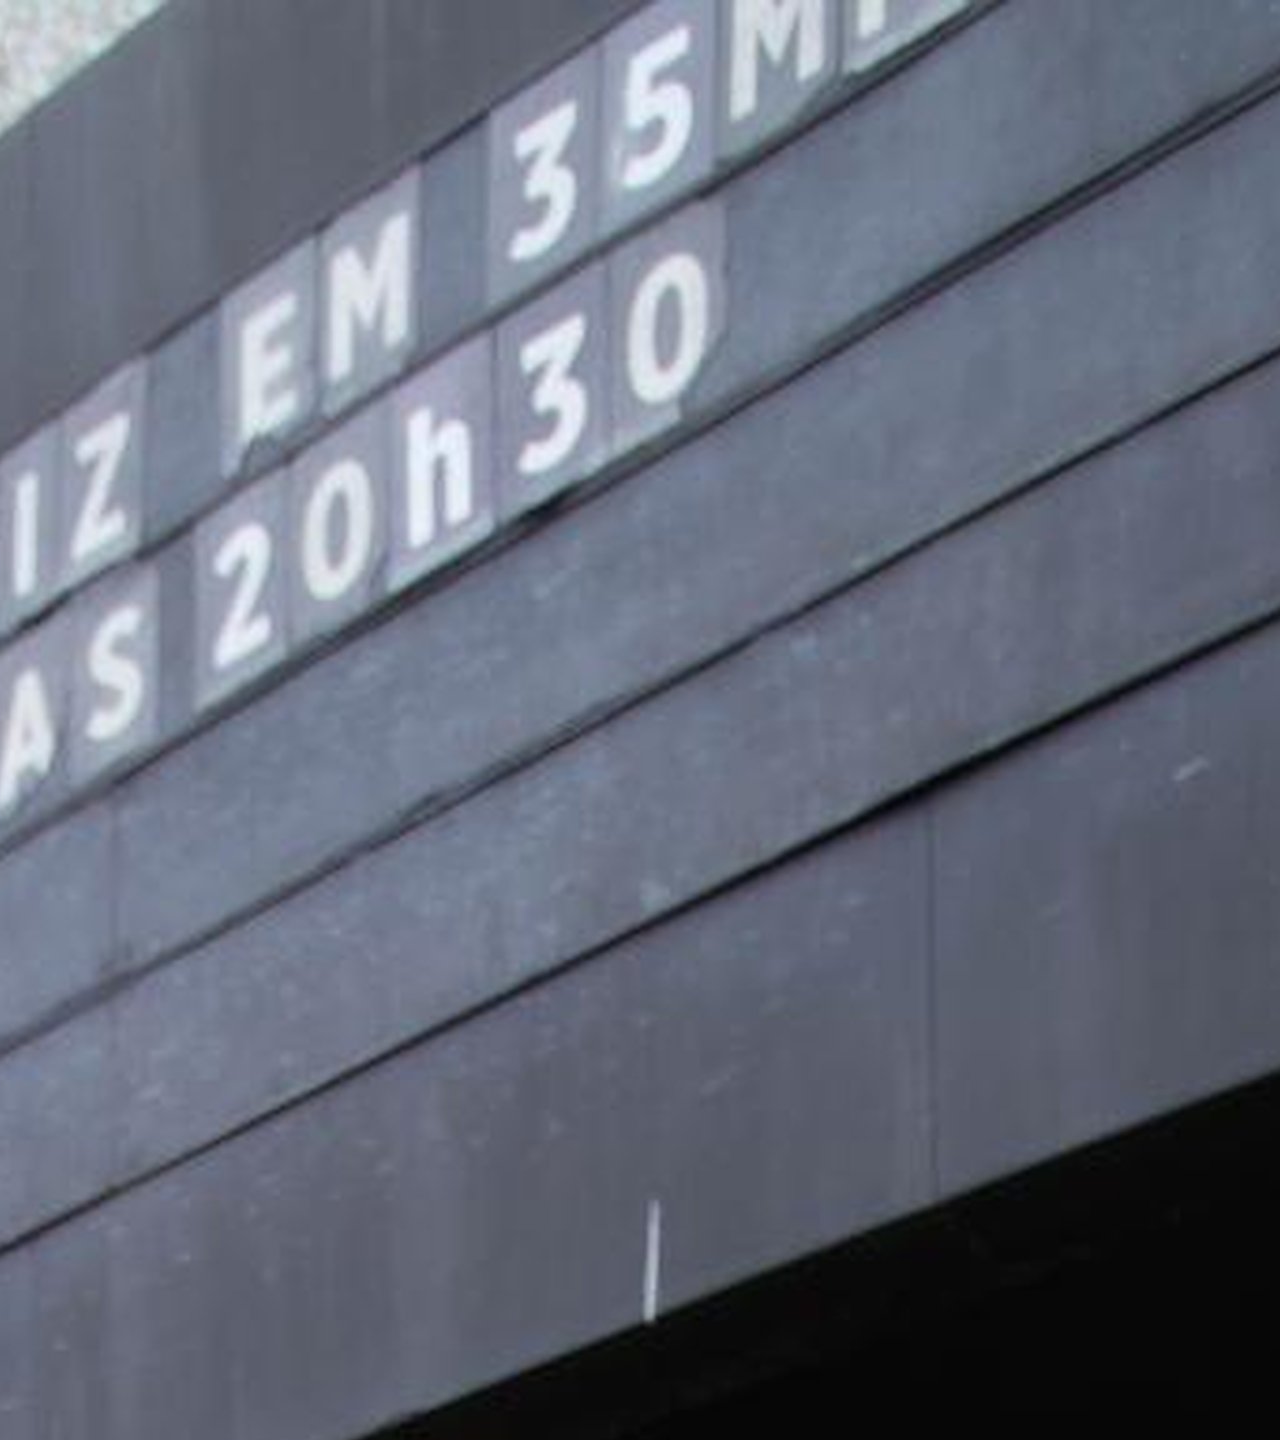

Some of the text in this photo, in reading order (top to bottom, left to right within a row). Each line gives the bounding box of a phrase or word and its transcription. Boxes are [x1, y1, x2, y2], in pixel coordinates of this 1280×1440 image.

[238, 211, 411, 443] EM
[507, 0, 886, 262] 35M
[212, 252, 711, 670] 20h30
